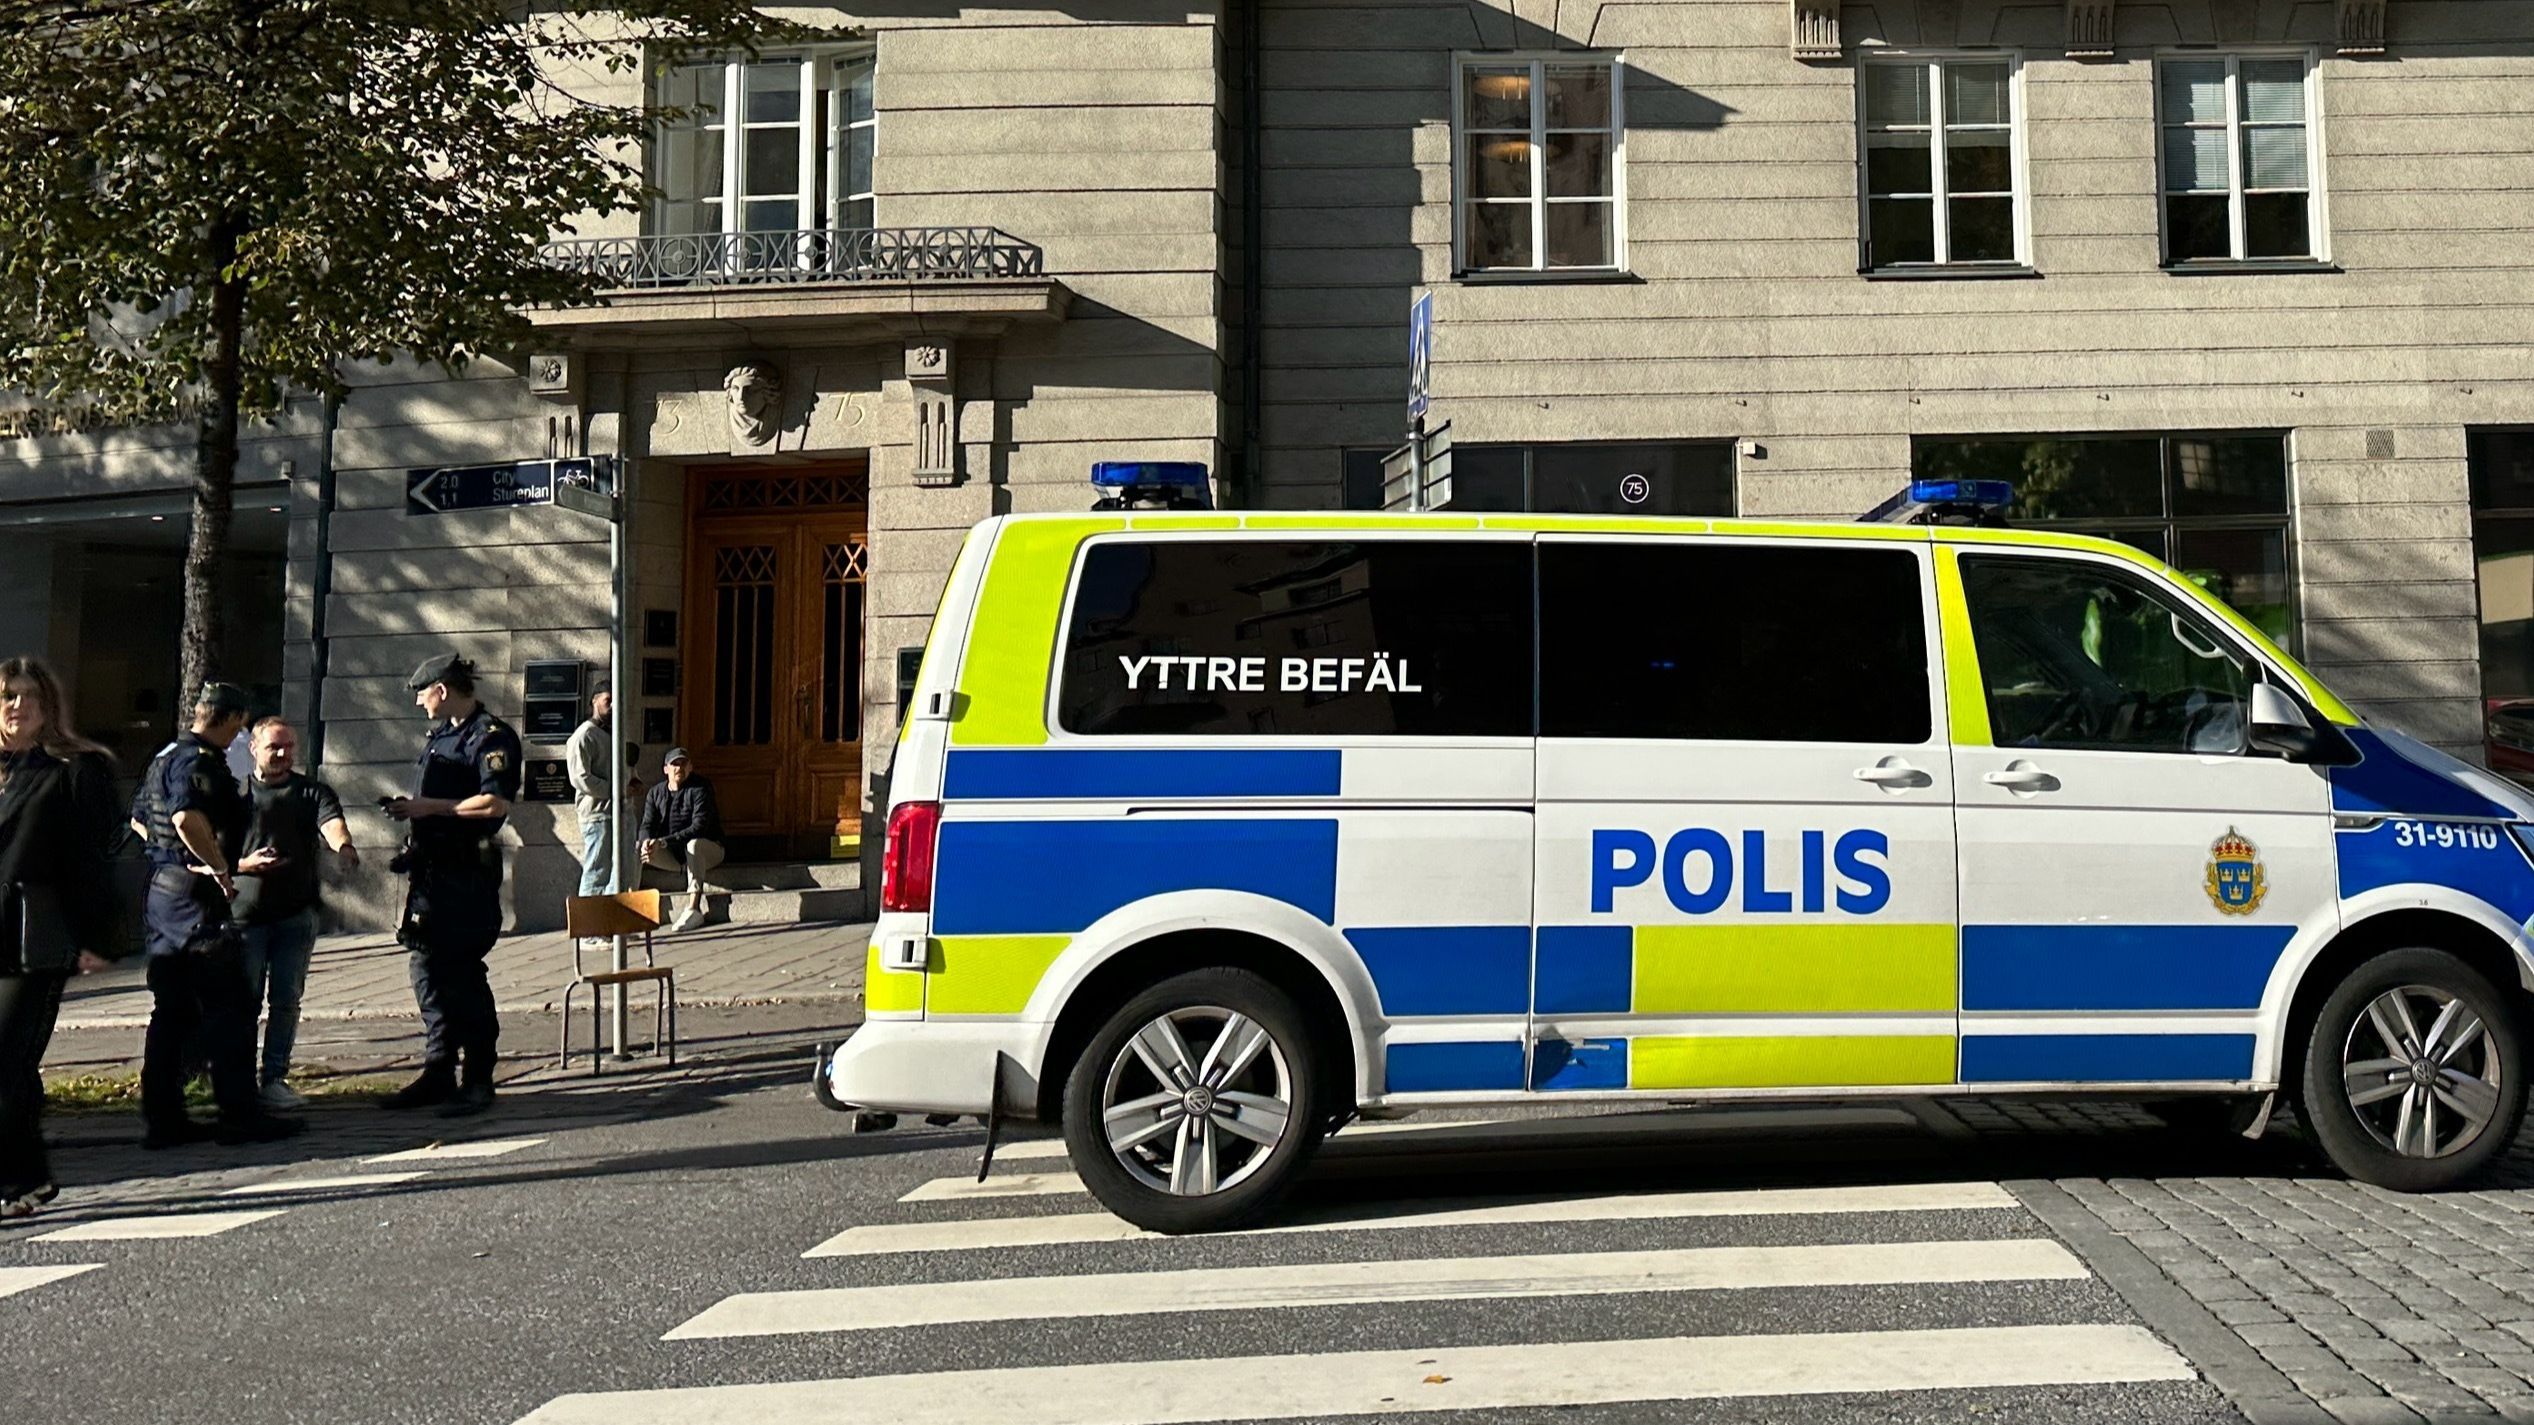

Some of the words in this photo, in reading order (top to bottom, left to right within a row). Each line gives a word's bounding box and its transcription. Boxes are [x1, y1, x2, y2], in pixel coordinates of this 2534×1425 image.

[828, 392, 868, 429] 75
[493, 471, 515, 485] City
[1626, 482, 1643, 495] 75
[493, 485, 549, 501] Stureplan
[1118, 655, 1266, 692] YTTRE
[1280, 651, 1423, 693] BEFÄL
[2395, 822, 2497, 849] 31-9110
[1591, 827, 1891, 915] POLIS
